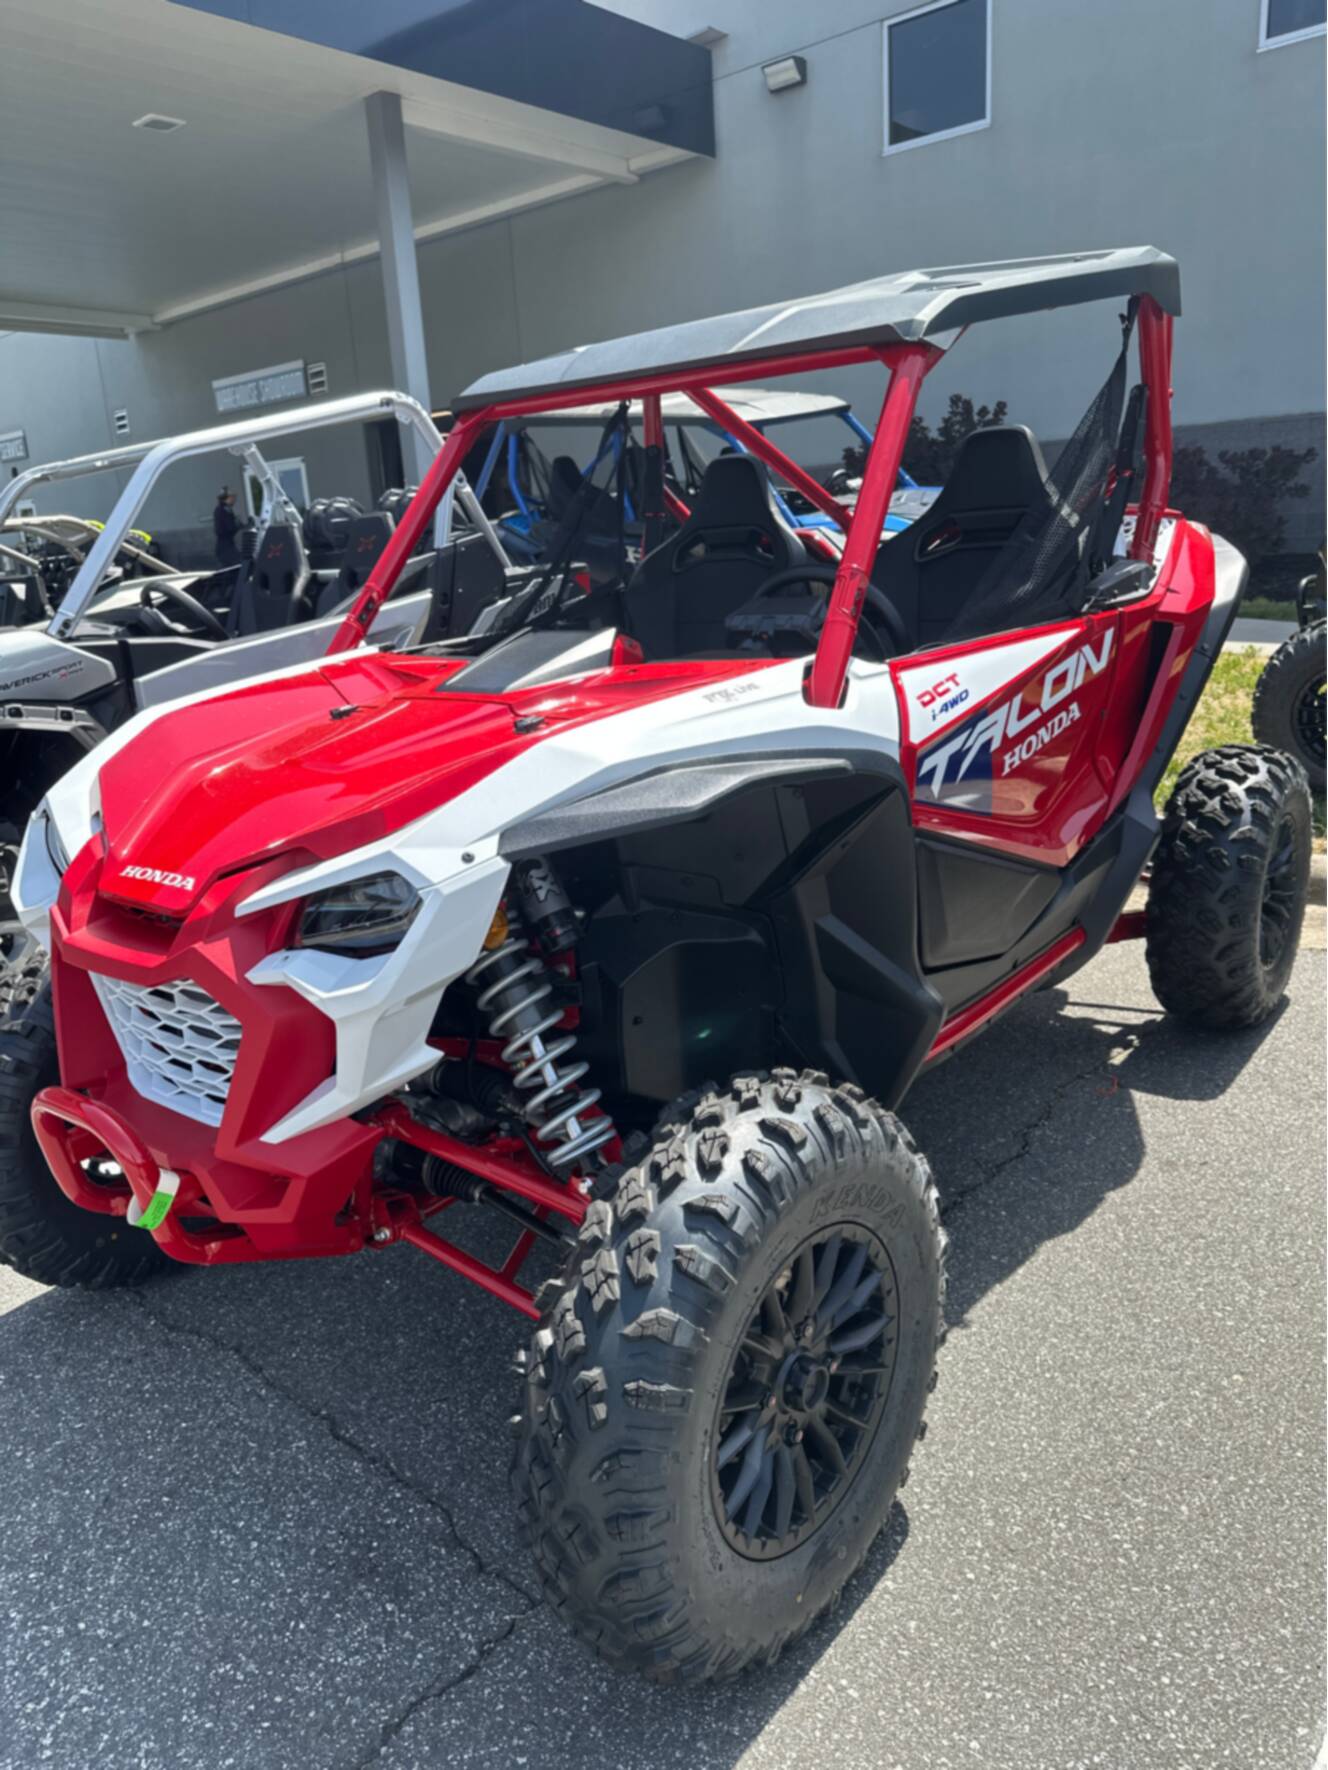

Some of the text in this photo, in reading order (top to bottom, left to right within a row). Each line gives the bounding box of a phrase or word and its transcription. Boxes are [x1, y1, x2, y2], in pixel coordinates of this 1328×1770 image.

[916, 673, 961, 708] DCT
[917, 626, 1115, 799] TALON
[1001, 701, 1082, 777] HONDA
[119, 865, 195, 891] HONDA
[808, 1183, 906, 1229] KENDA
